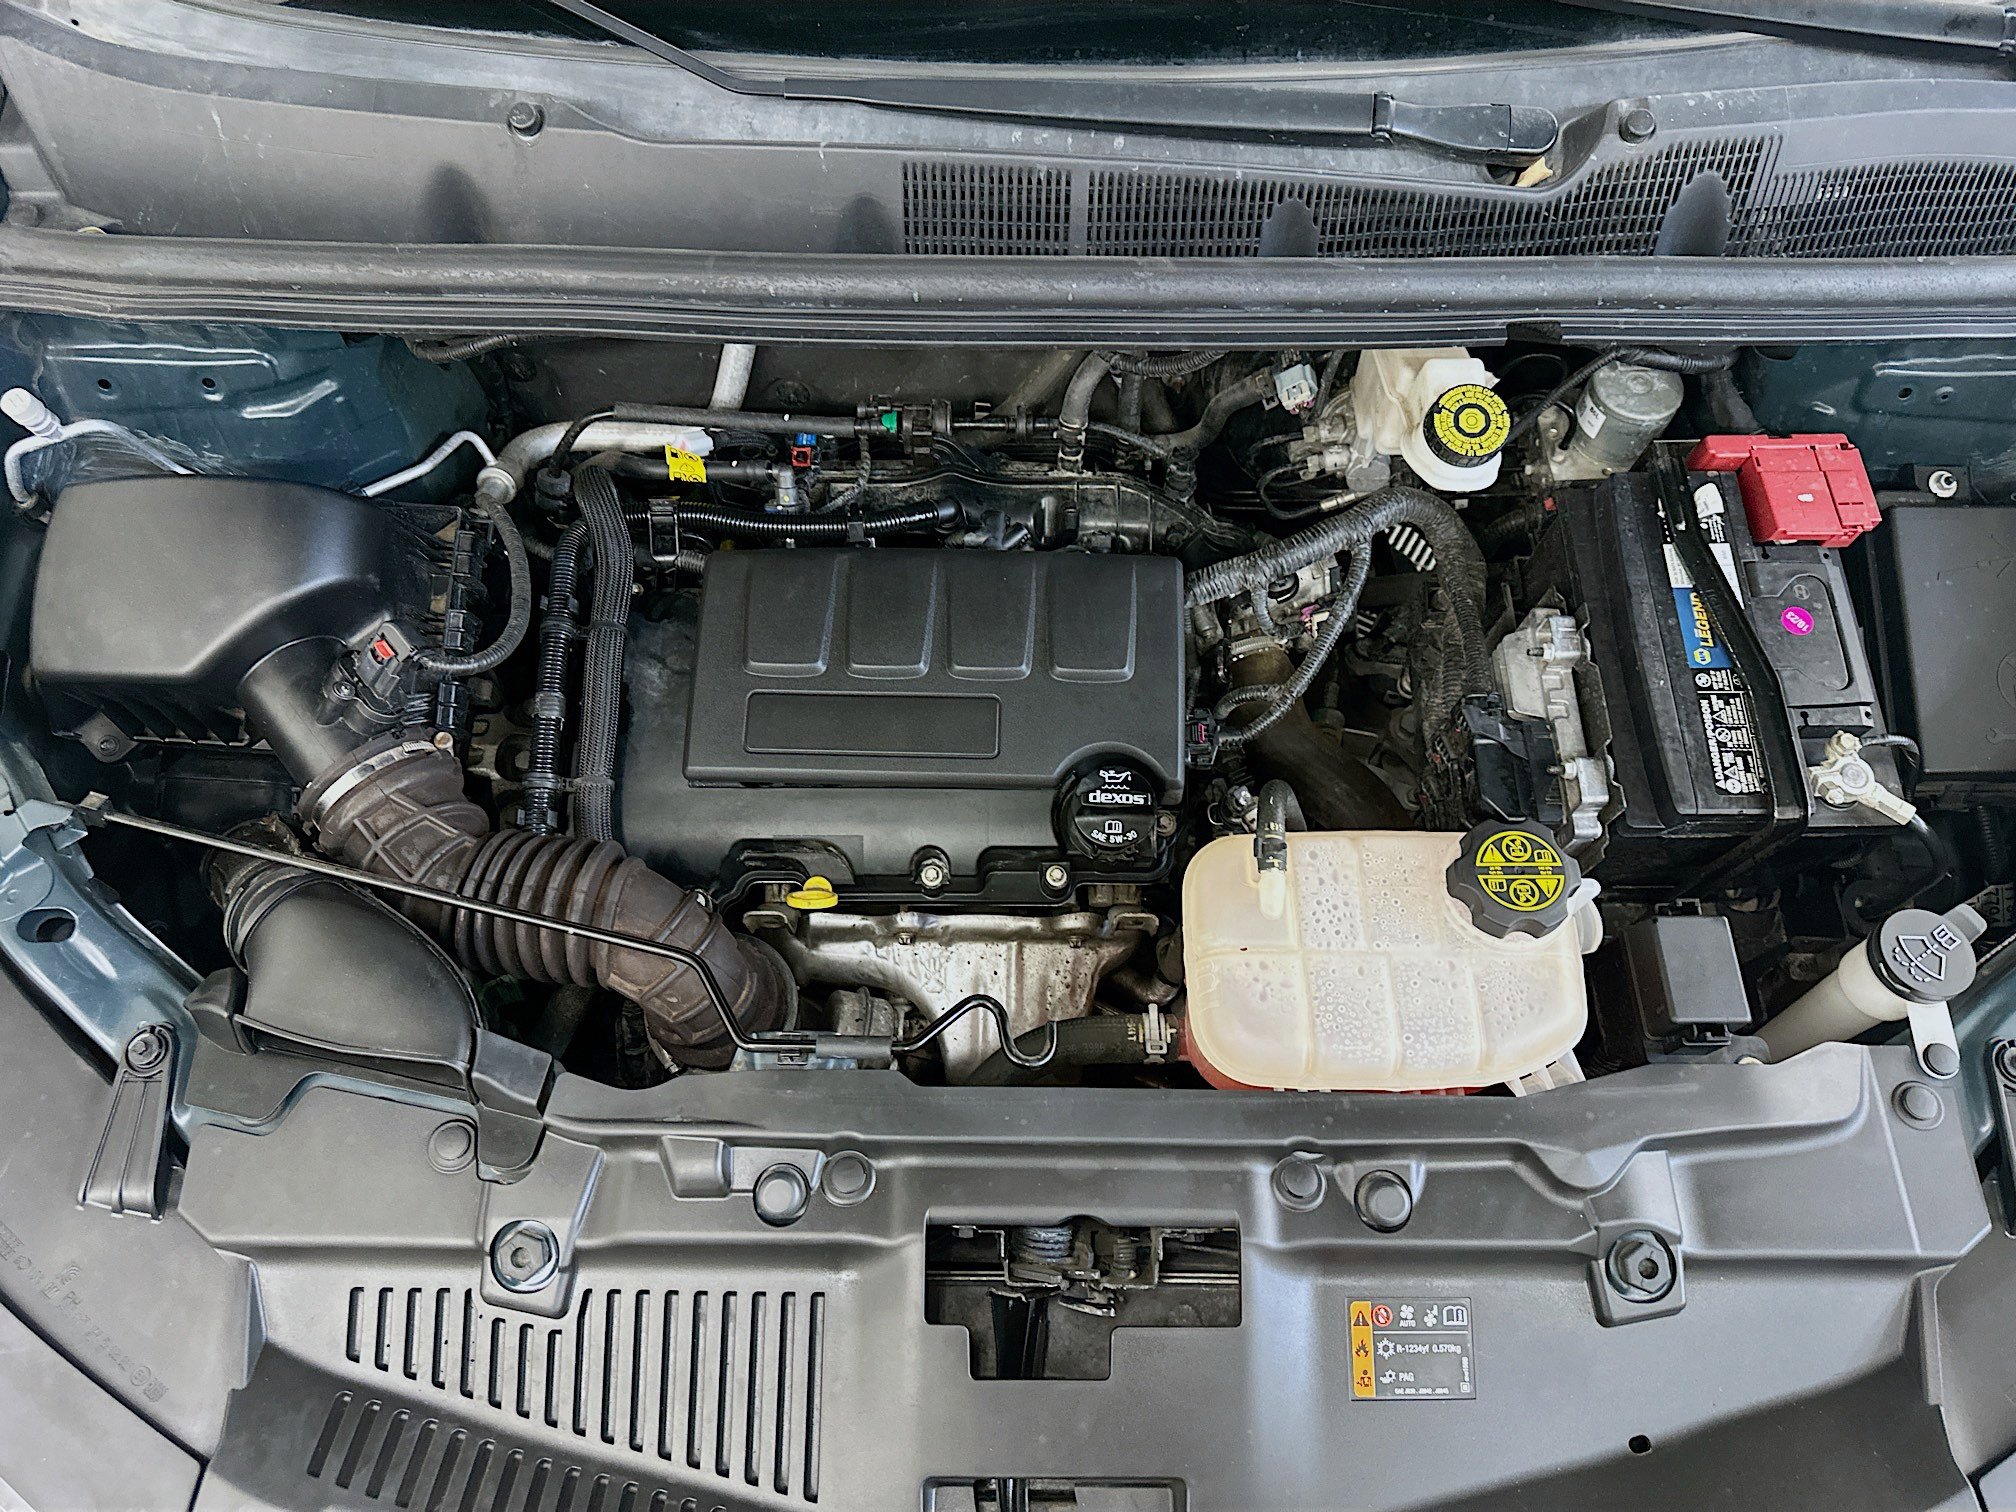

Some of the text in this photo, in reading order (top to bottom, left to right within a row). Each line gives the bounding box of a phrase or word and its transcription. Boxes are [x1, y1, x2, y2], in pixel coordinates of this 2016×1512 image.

[1690, 591, 1714, 647] LEGEND
[1785, 611, 1810, 632] 10/23
[1699, 699, 1724, 780] DANGER/POISON
[1088, 790, 1145, 805] dexos
[1090, 829, 1138, 844] SAE 5W-30
[1399, 1320, 1417, 1328] AUTO
[1396, 1343, 1430, 1355] R-1234yf
[1398, 1372, 1415, 1382] PAG
